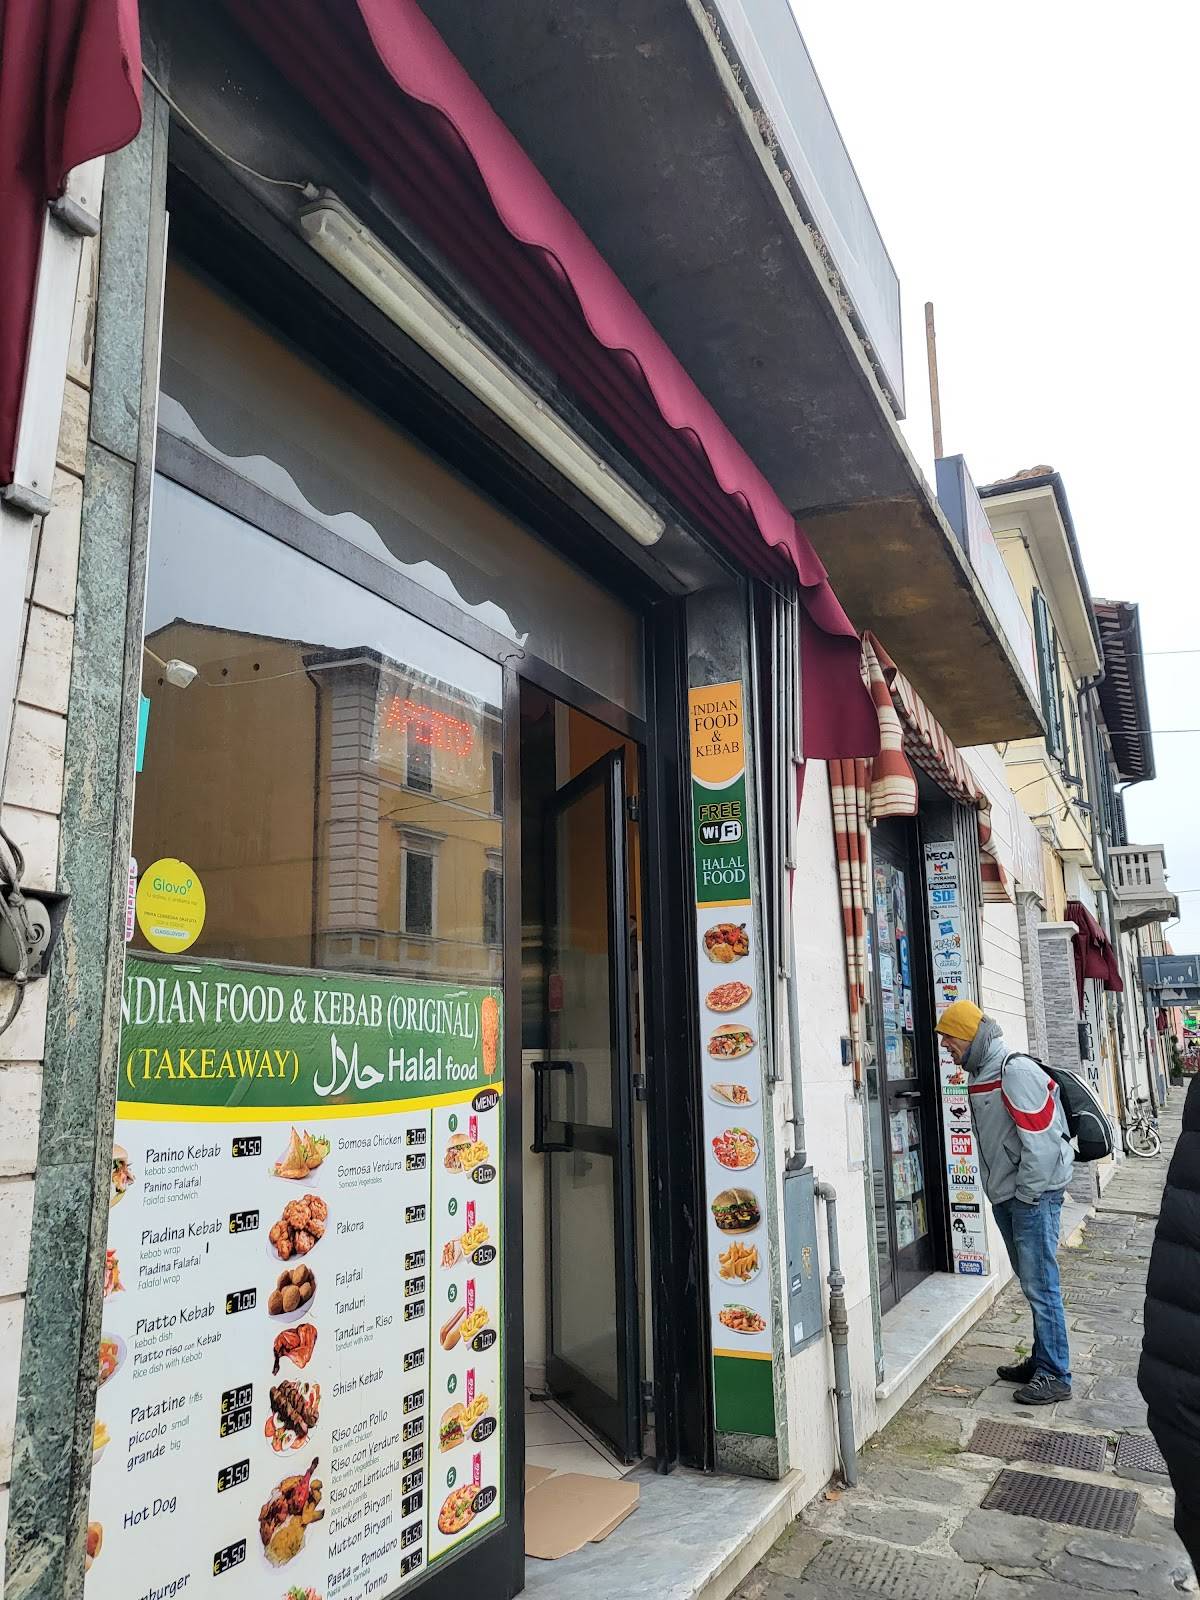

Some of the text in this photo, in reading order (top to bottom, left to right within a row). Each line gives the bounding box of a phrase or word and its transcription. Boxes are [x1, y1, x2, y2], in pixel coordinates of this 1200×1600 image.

[694, 699, 738, 716] INDIAN
[695, 713, 738, 732] FOOD
[711, 730, 721, 742] &
[696, 741, 740, 758] KEBAB
[699, 801, 742, 821] FREE
[702, 856, 745, 870] HALAL
[926, 852, 955, 862] NECA
[153, 878, 187, 896] Glovo
[703, 869, 746, 886] FOOD
[936, 976, 962, 984] ALTER
[215, 982, 284, 1024] FOOD
[290, 988, 307, 1024] &
[313, 990, 382, 1028] KEBAB
[386, 992, 479, 1050] (ORIGINAL)
[126, 1047, 299, 1089] (TAKEAWAY)
[313, 1032, 385, 1097] حلال
[388, 1047, 478, 1082] Halal food
[338, 1137, 372, 1150] Somosa
[373, 1134, 402, 1147] Chicken
[952, 1137, 970, 1146] BAN
[146, 1140, 261, 1164] Panino Kebab €4.50
[168, 1162, 199, 1174] sandwich
[338, 1164, 371, 1178] Somosa
[372, 1160, 402, 1172] Verdura
[948, 1164, 978, 1174] FUNKO
[144, 1180, 172, 1194] Panino
[952, 1174, 975, 1184] IRON
[450, 1201, 456, 1213] 2
[142, 1214, 259, 1246] Piadina Kebab €5.00
[336, 1220, 364, 1234] Pakora
[163, 1245, 181, 1256] wrap
[139, 1262, 171, 1278] Piadina
[163, 1274, 181, 1286] wrap
[136, 1292, 256, 1336] Piatto Kebab €7.00
[335, 1296, 366, 1314] Tanduri
[158, 1330, 174, 1342] dish
[334, 1320, 365, 1342] Tanduri
[376, 1314, 393, 1328] Riso
[134, 1350, 164, 1366] Piatto
[166, 1344, 183, 1356] riso
[196, 1331, 222, 1348] Kebab
[132, 1367, 148, 1380] Rice
[149, 1362, 164, 1376] dish
[166, 1357, 180, 1369] with
[332, 1378, 357, 1398] Shish
[359, 1368, 384, 1386] Kebab
[449, 1376, 456, 1391] 4
[130, 1395, 186, 1424] Patatine
[221, 1388, 252, 1412] €3.00
[128, 1411, 251, 1452] piccolo small €5.00
[331, 1428, 351, 1444] Riso
[352, 1420, 368, 1434] con
[370, 1410, 388, 1426] Pollo
[127, 1440, 182, 1472] grande big
[330, 1457, 350, 1474] Riso
[352, 1448, 367, 1464] con
[368, 1434, 400, 1456] Verdure
[330, 1488, 348, 1504] Riso
[348, 1480, 362, 1494] con
[363, 1460, 400, 1487] Lenticchia
[448, 1470, 455, 1485] 5
[123, 1464, 249, 1530] Hot Dog €3.50
[328, 1510, 362, 1535] Chicken
[364, 1488, 393, 1516] Biryani
[328, 1532, 362, 1560] Mutton
[364, 1510, 393, 1538] Biryani
[213, 1544, 246, 1575] €5.50
[328, 1566, 351, 1590] Pasta
[362, 1538, 398, 1568] Pomodoro
[364, 1573, 388, 1595] Tonno
